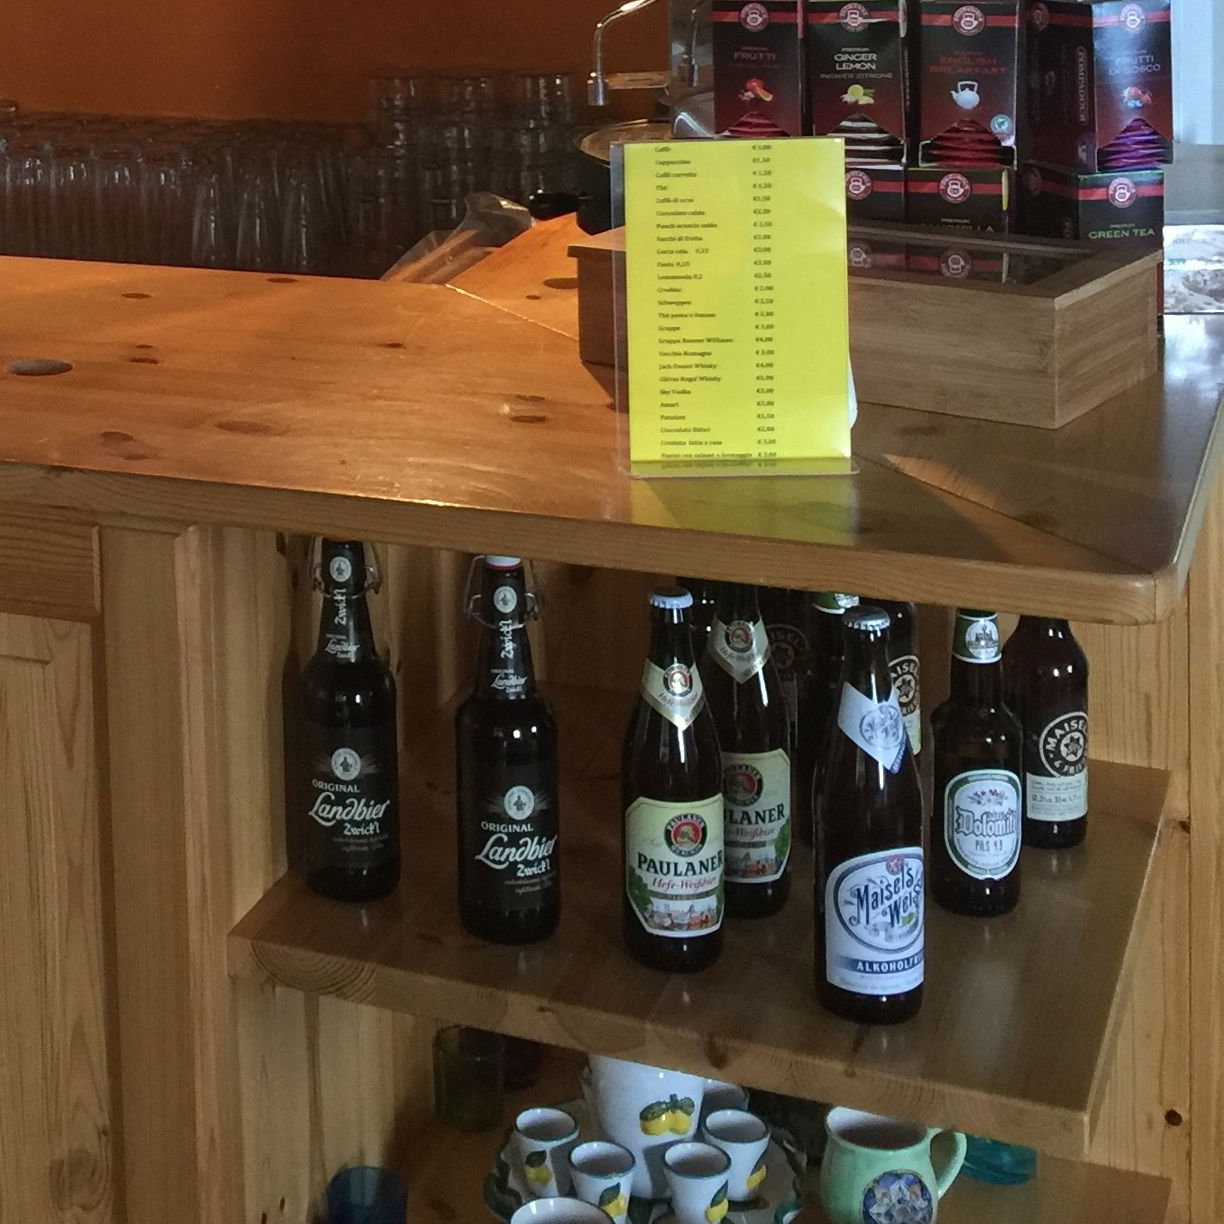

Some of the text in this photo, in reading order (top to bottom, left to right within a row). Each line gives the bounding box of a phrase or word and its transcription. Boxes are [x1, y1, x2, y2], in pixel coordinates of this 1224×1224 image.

[834, 53, 877, 62] GINGER
[836, 62, 876, 71] LEMON
[1088, 228, 1156, 240] GREEN TEA
[1045, 719, 1086, 752] MAISE
[312, 779, 361, 794] ORIGINAL
[308, 792, 391, 827] Landbier
[728, 803, 785, 825] LANER
[481, 821, 534, 834] ORIGINAL
[475, 833, 558, 871] Landbier
[637, 850, 723, 877] PAULANER
